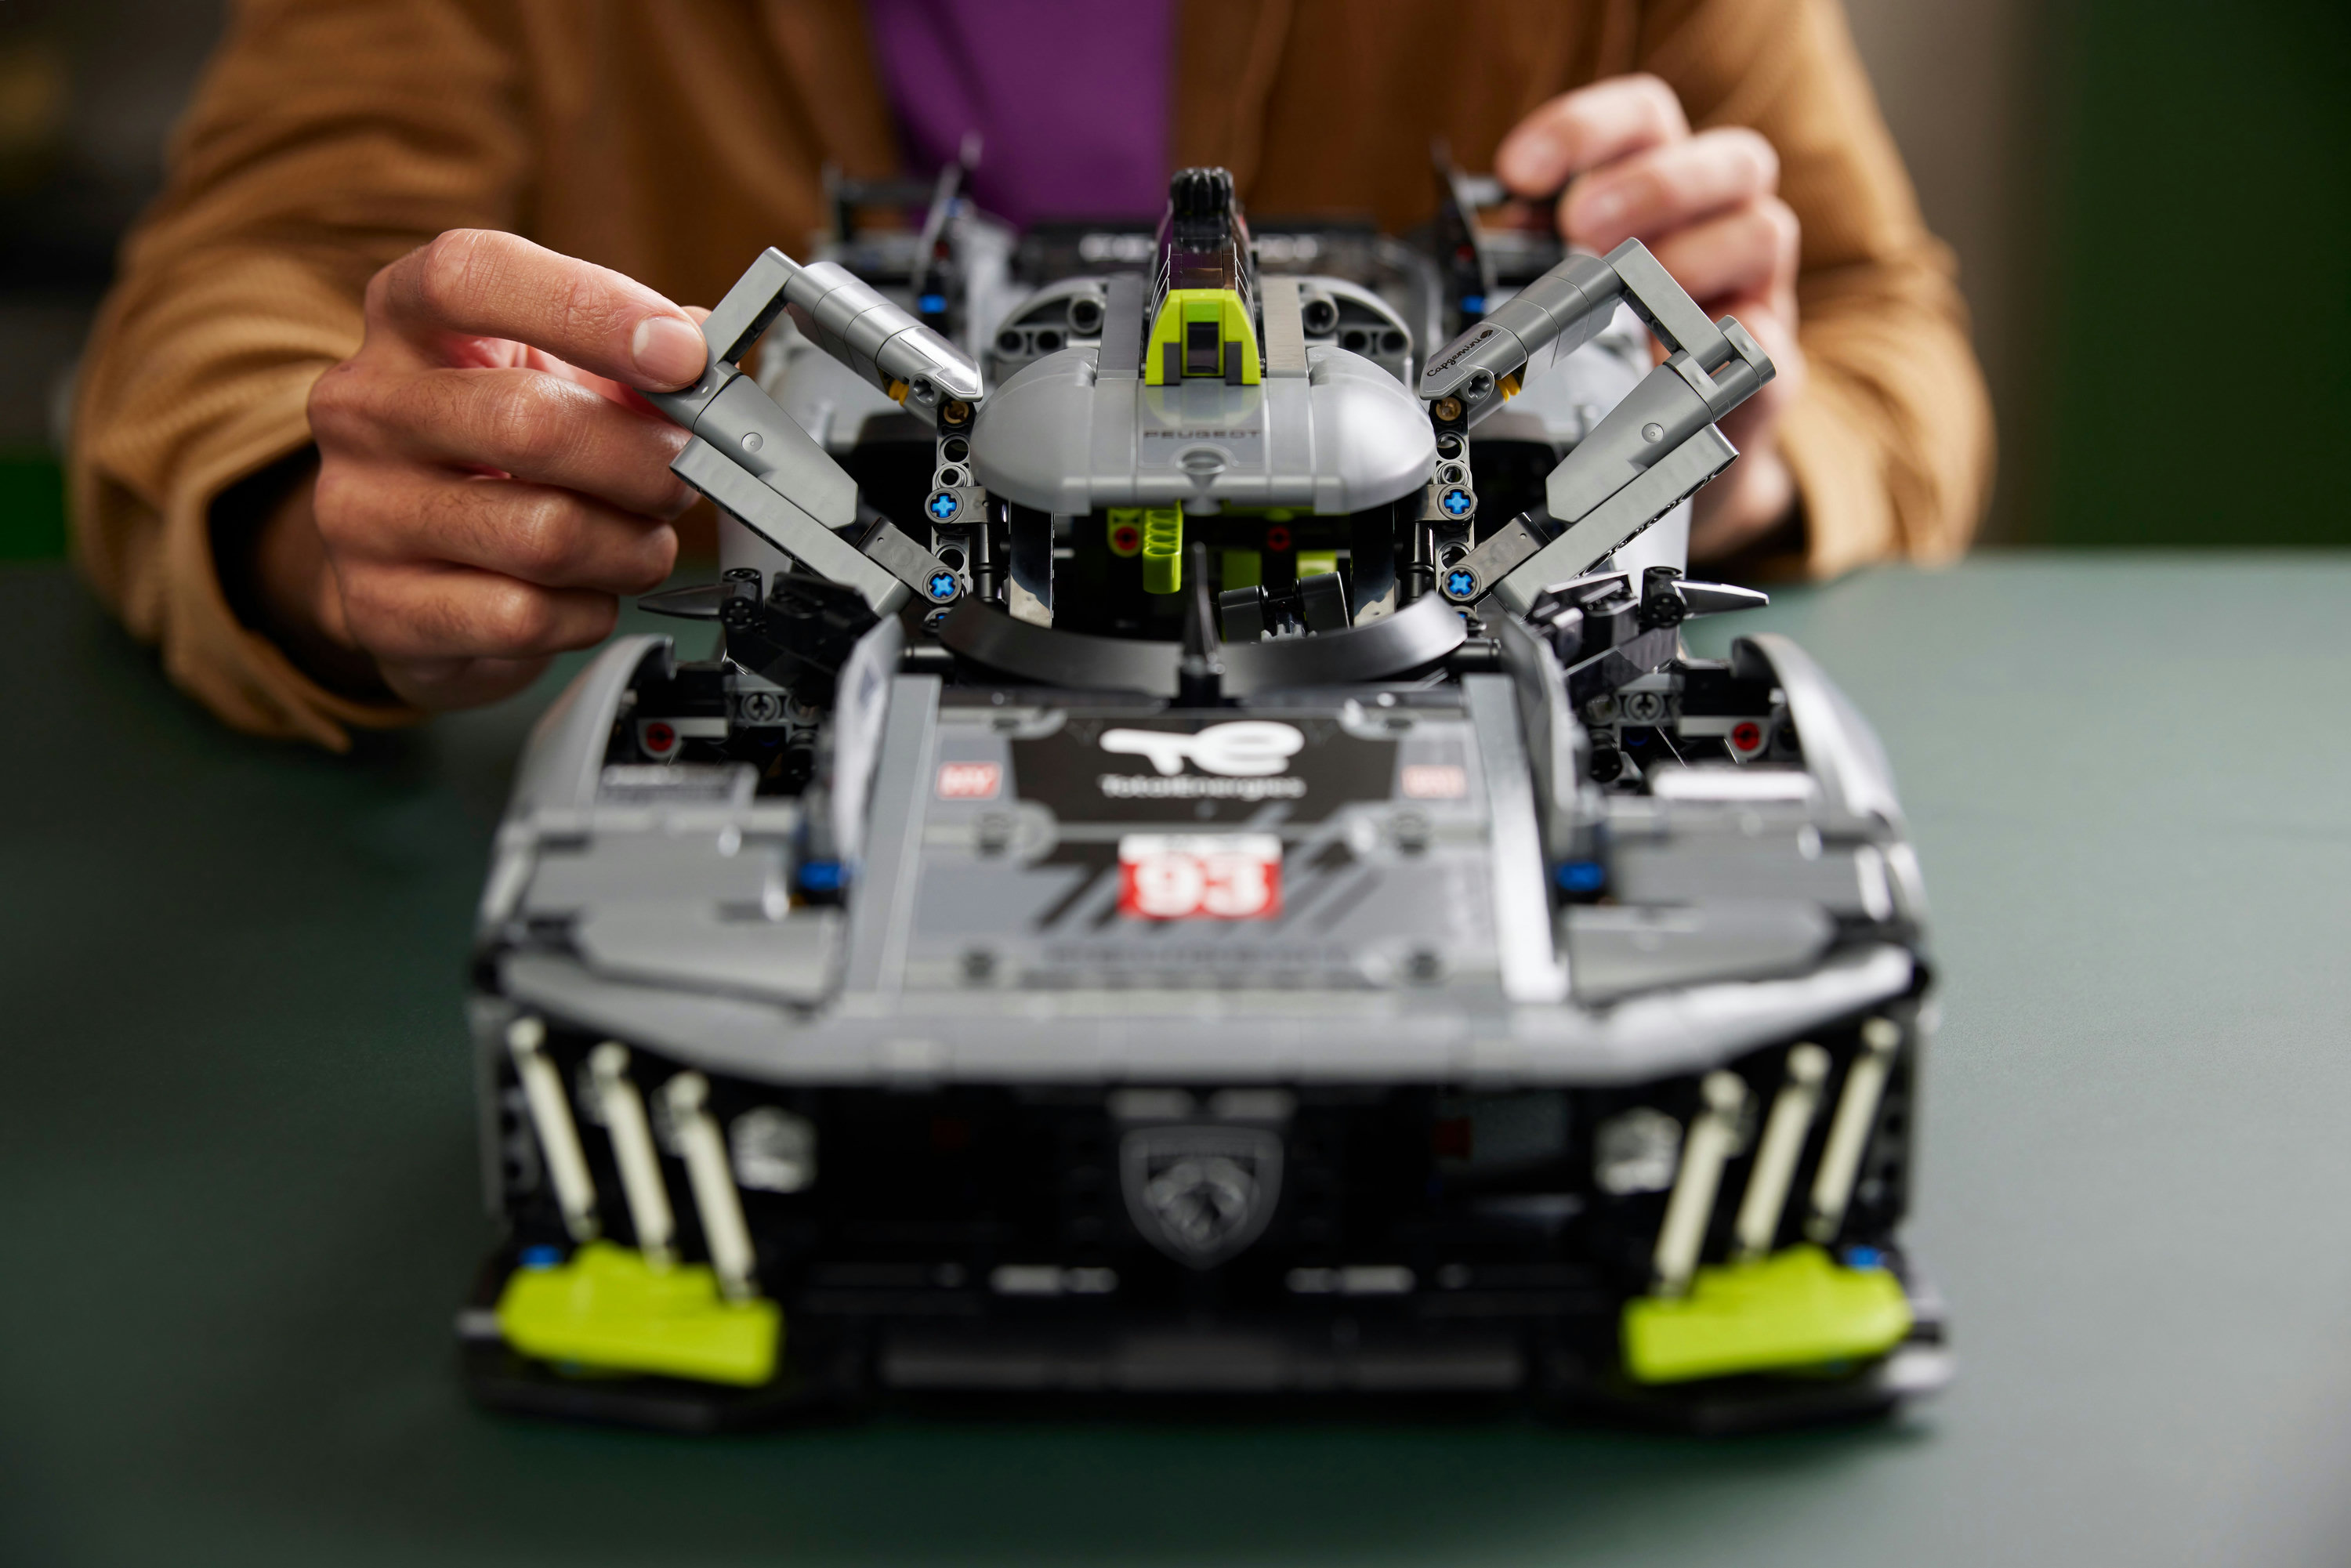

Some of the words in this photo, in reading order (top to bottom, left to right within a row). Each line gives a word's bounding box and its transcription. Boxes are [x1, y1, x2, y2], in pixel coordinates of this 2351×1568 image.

[1427, 338, 1482, 377] Capgemini
[1143, 430, 1261, 439] PEUGEOT
[1100, 774, 1306, 802] TotalEnergies
[1134, 853, 1270, 916] 93
